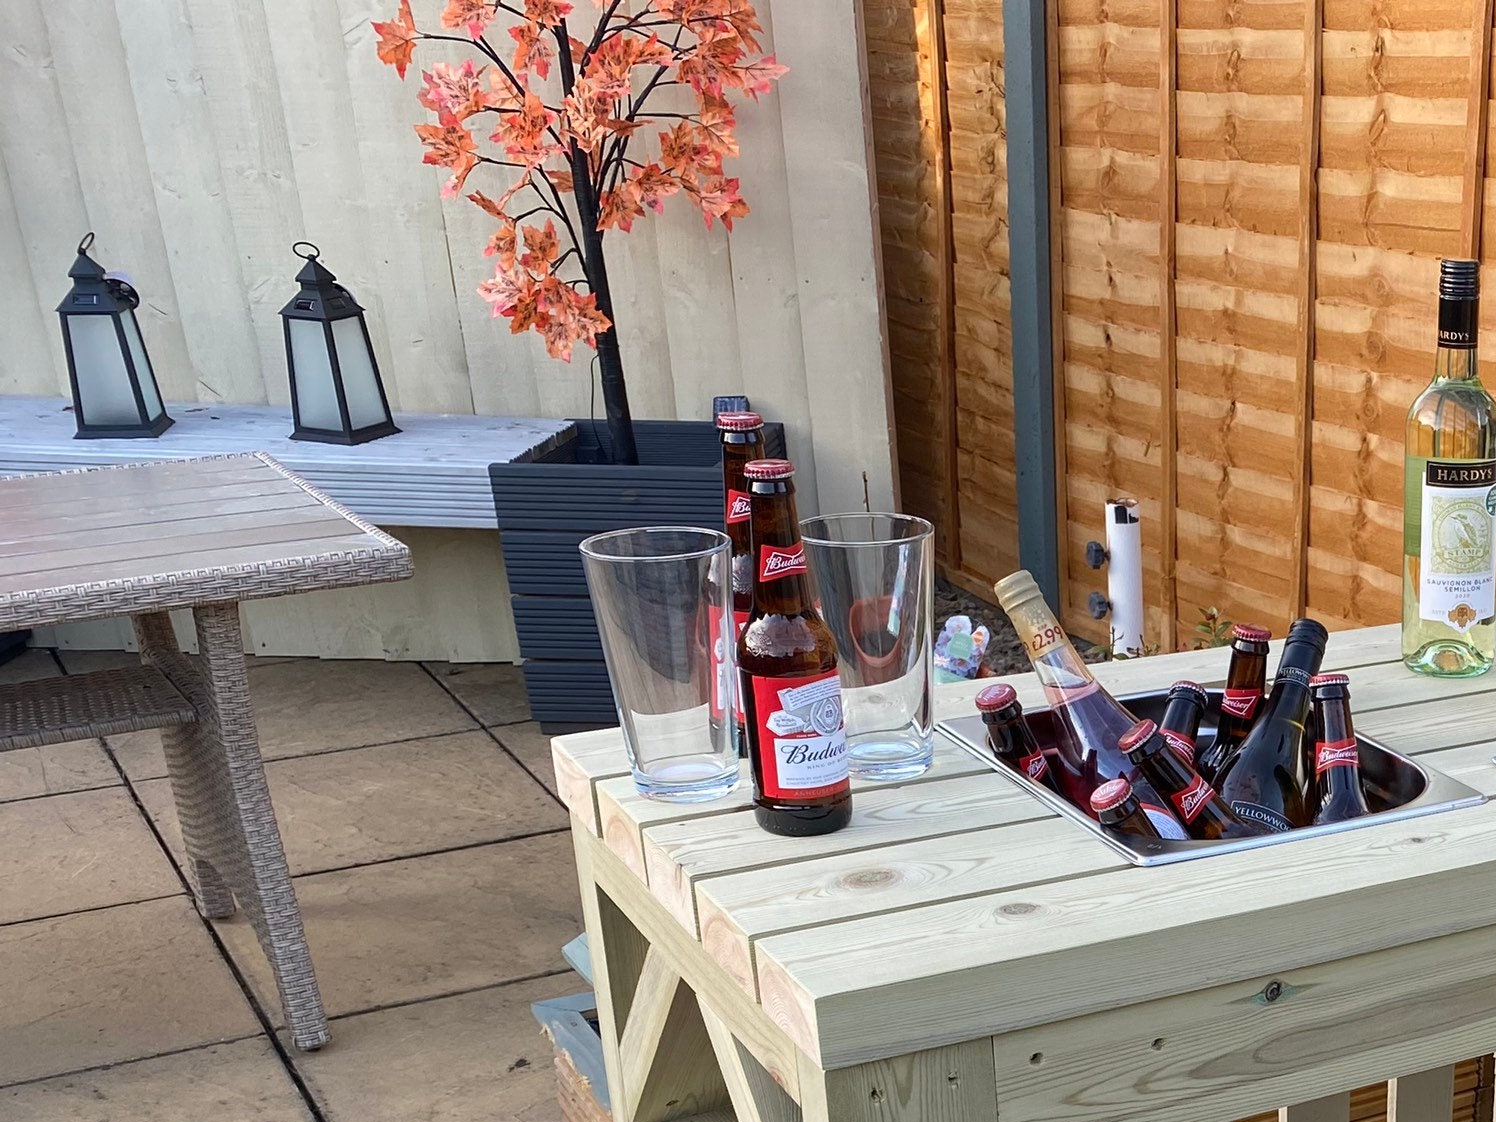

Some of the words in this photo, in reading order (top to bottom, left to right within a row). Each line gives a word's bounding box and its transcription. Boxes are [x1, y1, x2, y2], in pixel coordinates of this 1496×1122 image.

[1437, 468, 1492, 481] HARDYS
[1447, 548, 1481, 557] STAMP
[1427, 578, 1472, 586] SAUVIGNON
[1474, 576, 1493, 585] BLANC
[1032, 625, 1063, 652] £2.99
